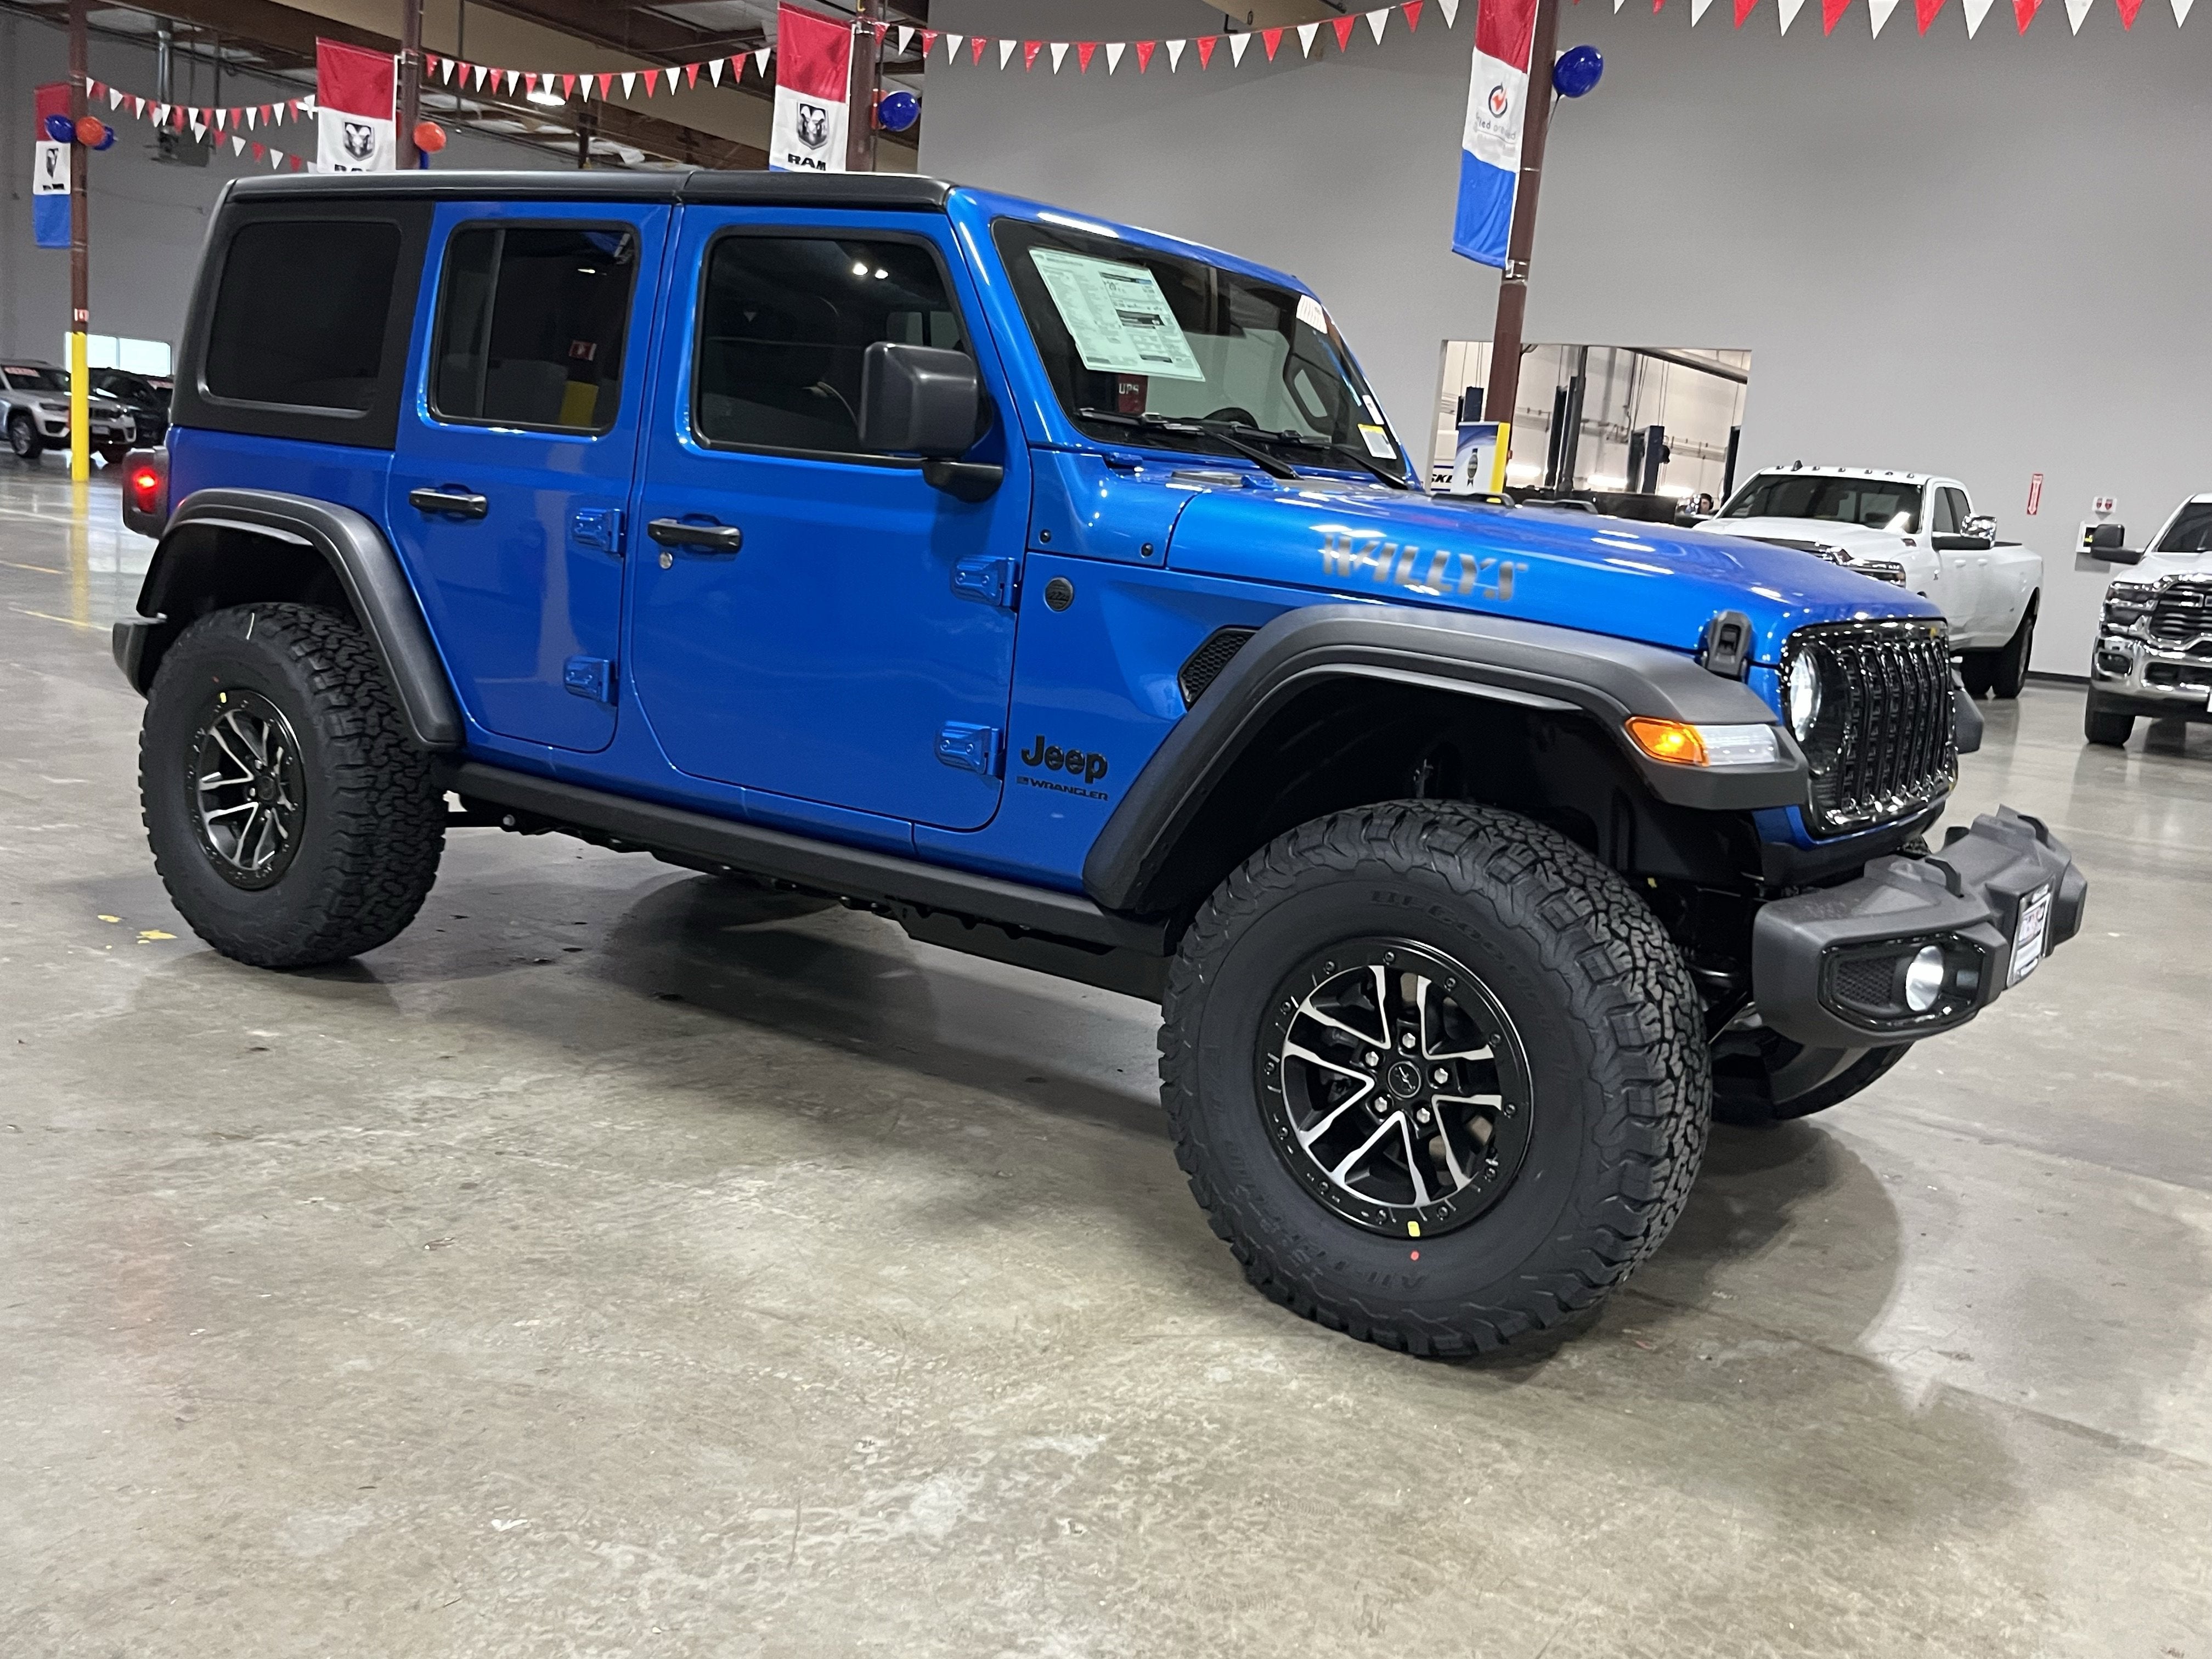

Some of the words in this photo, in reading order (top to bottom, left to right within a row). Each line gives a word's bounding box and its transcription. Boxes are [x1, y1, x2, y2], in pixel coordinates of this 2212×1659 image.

[788, 153, 826, 171] RAM
[1323, 534, 1529, 601] WILLYS
[1021, 735, 1108, 785] Jeep
[1029, 777, 1109, 802] WRANGLER
